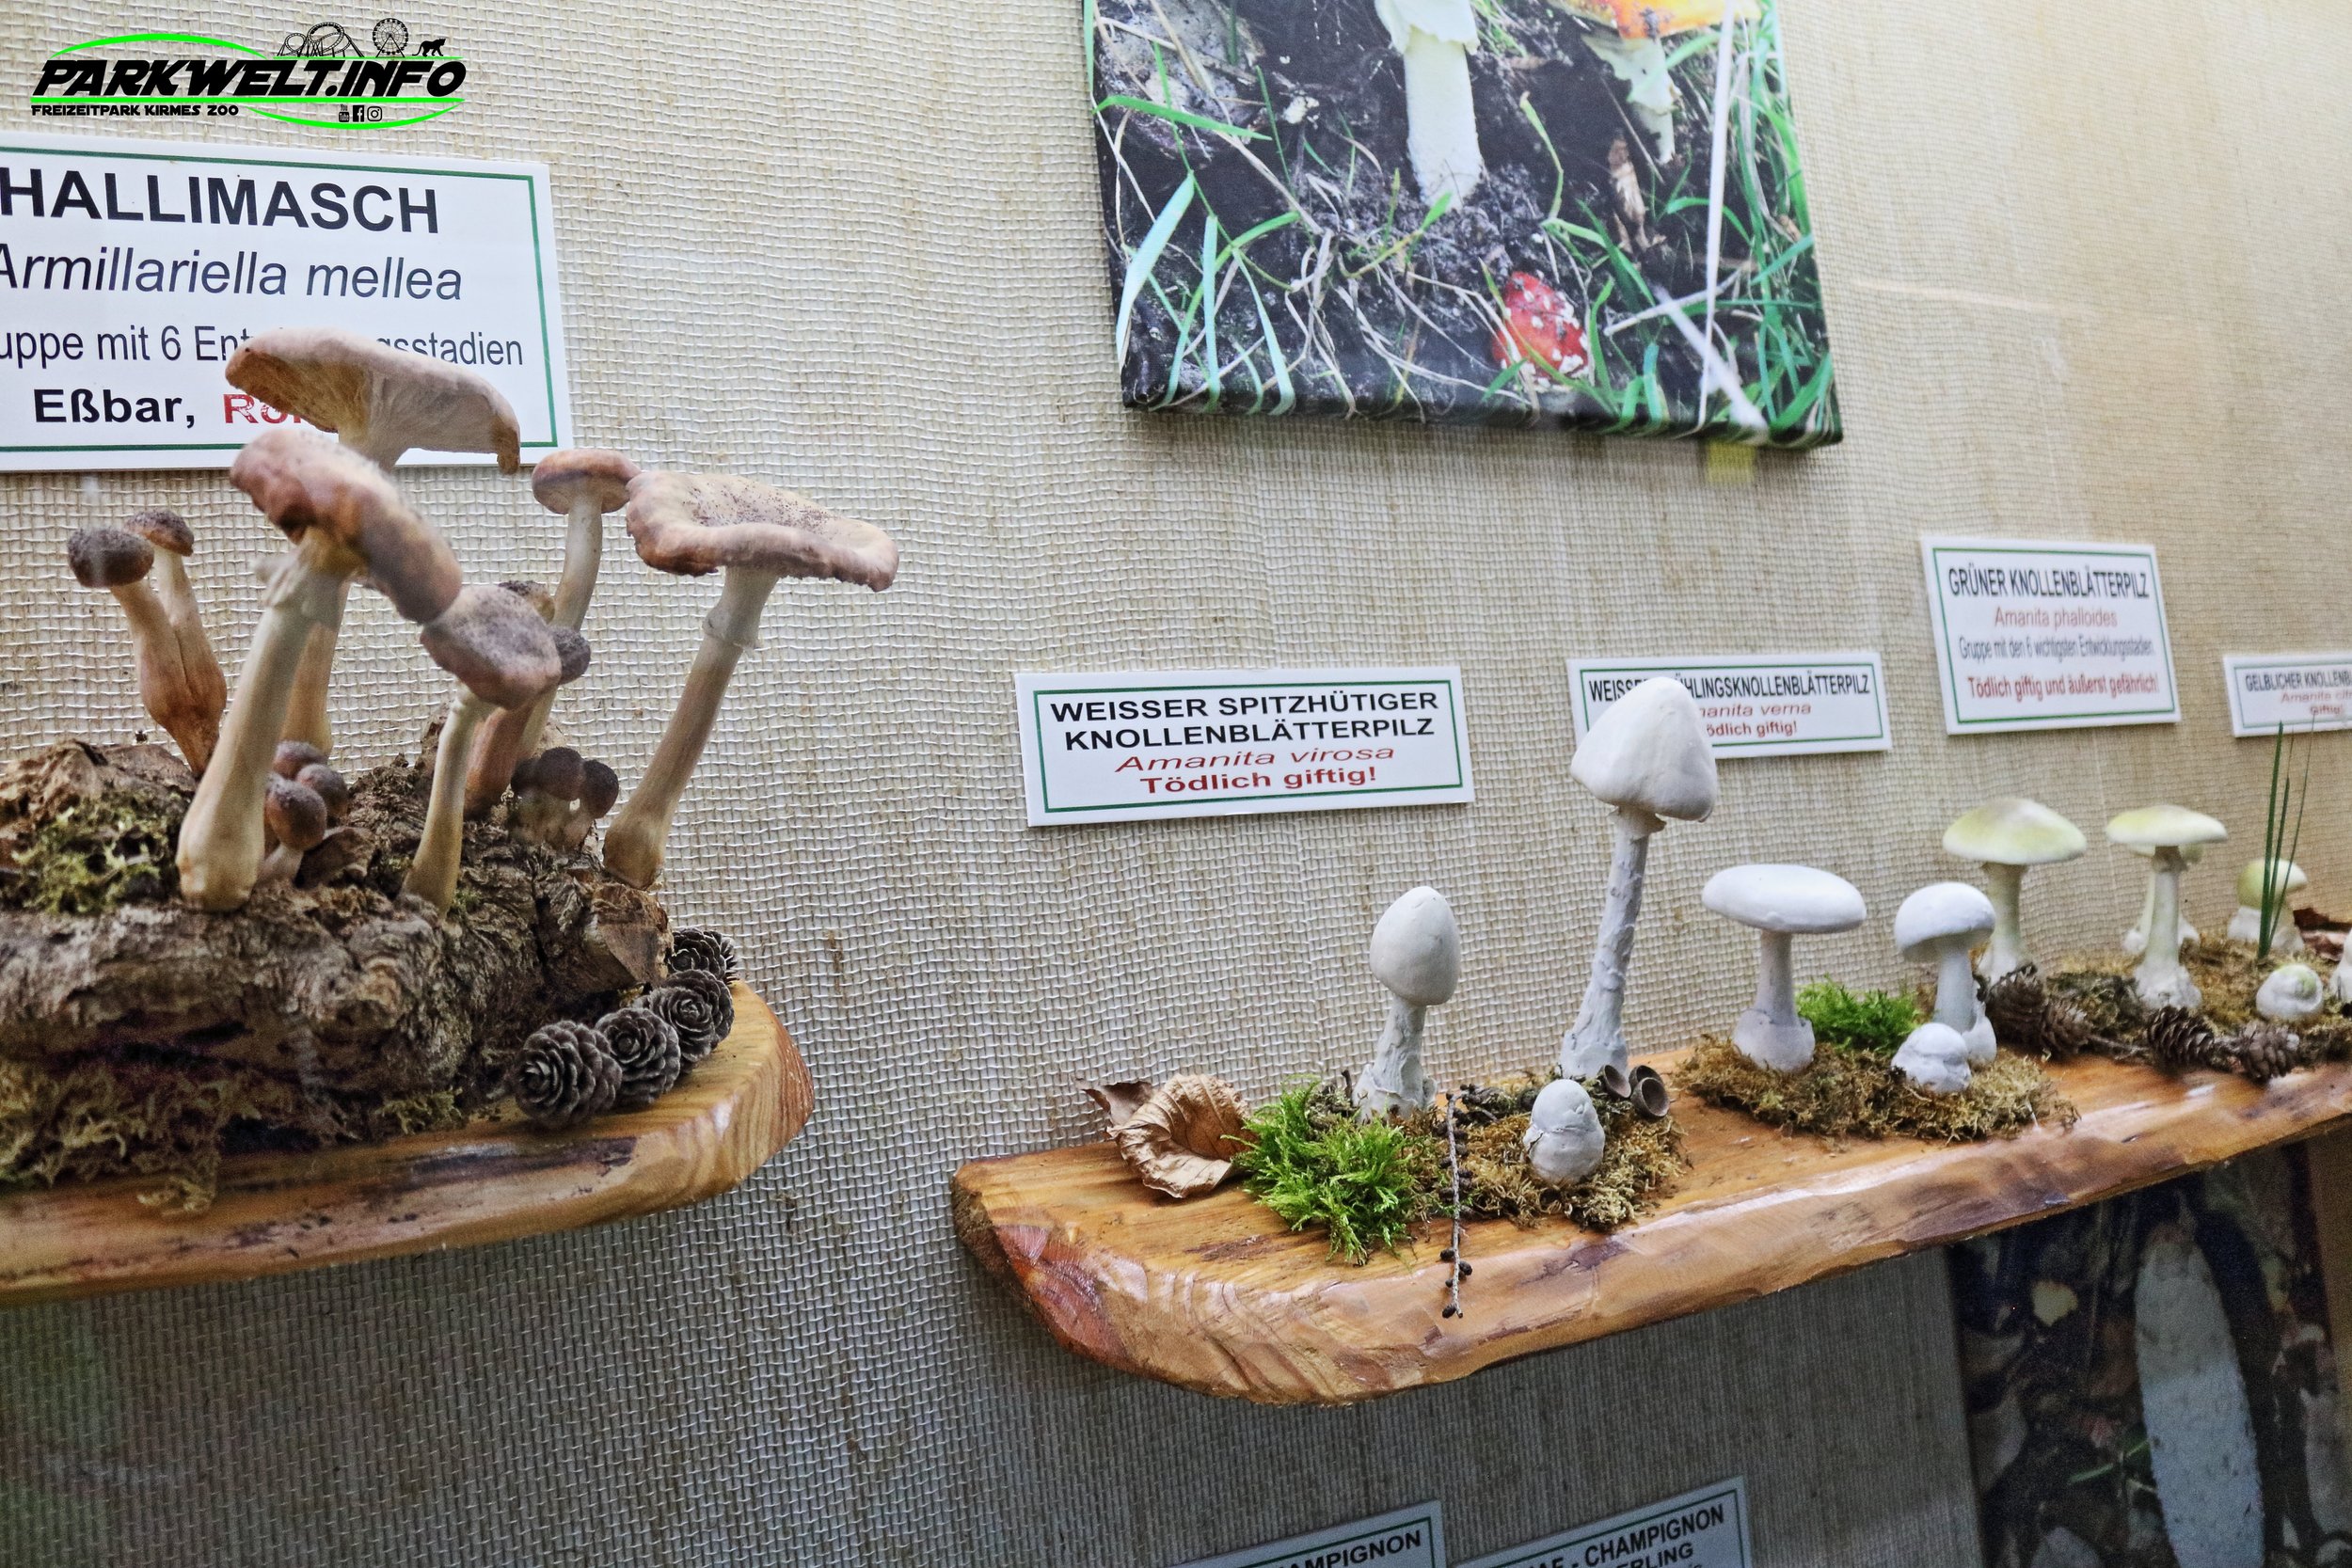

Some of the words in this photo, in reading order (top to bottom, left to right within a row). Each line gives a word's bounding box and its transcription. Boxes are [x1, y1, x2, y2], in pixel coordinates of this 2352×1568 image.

[0, 166, 438, 233] HALLIMASCH
[0, 243, 286, 295] Armillariella
[307, 257, 461, 300] mellea
[97, 325, 151, 361] mit
[161, 326, 182, 361] 6
[35, 388, 195, 429] Eßbar,
[1948, 562, 2007, 596] GRÜNER
[2010, 564, 2150, 598] KNOLLENBLÄTTERPILZ
[1994, 607, 2049, 626] Amanita
[2054, 608, 2118, 629] phalloides
[1959, 636, 1992, 664] Gruppe
[1994, 638, 2006, 657] mit
[1967, 675, 2011, 699] Tödlich
[2014, 674, 2043, 702] giftig
[2045, 675, 2065, 694] und
[2069, 673, 2107, 694] äußerst
[2245, 672, 2302, 691] GELBLICHER
[2304, 669, 2352, 689] KNOLLENB
[1051, 699, 1209, 722] WEISSER
[1218, 690, 1438, 716] SPITZHÜTIGER
[1760, 705, 1812, 717] verna
[1065, 718, 1435, 751] KNOLLENBLÄTTERPILZ
[1707, 721, 1750, 736] ödlich
[1756, 721, 1797, 738] giftig!
[1115, 751, 1275, 772] Amanita
[1291, 748, 1394, 765] virosa
[1140, 772, 1271, 794] Tödlich
[1283, 766, 1377, 789] giftig!
[1584, 1503, 1724, 1567] CHAMPIGNON
